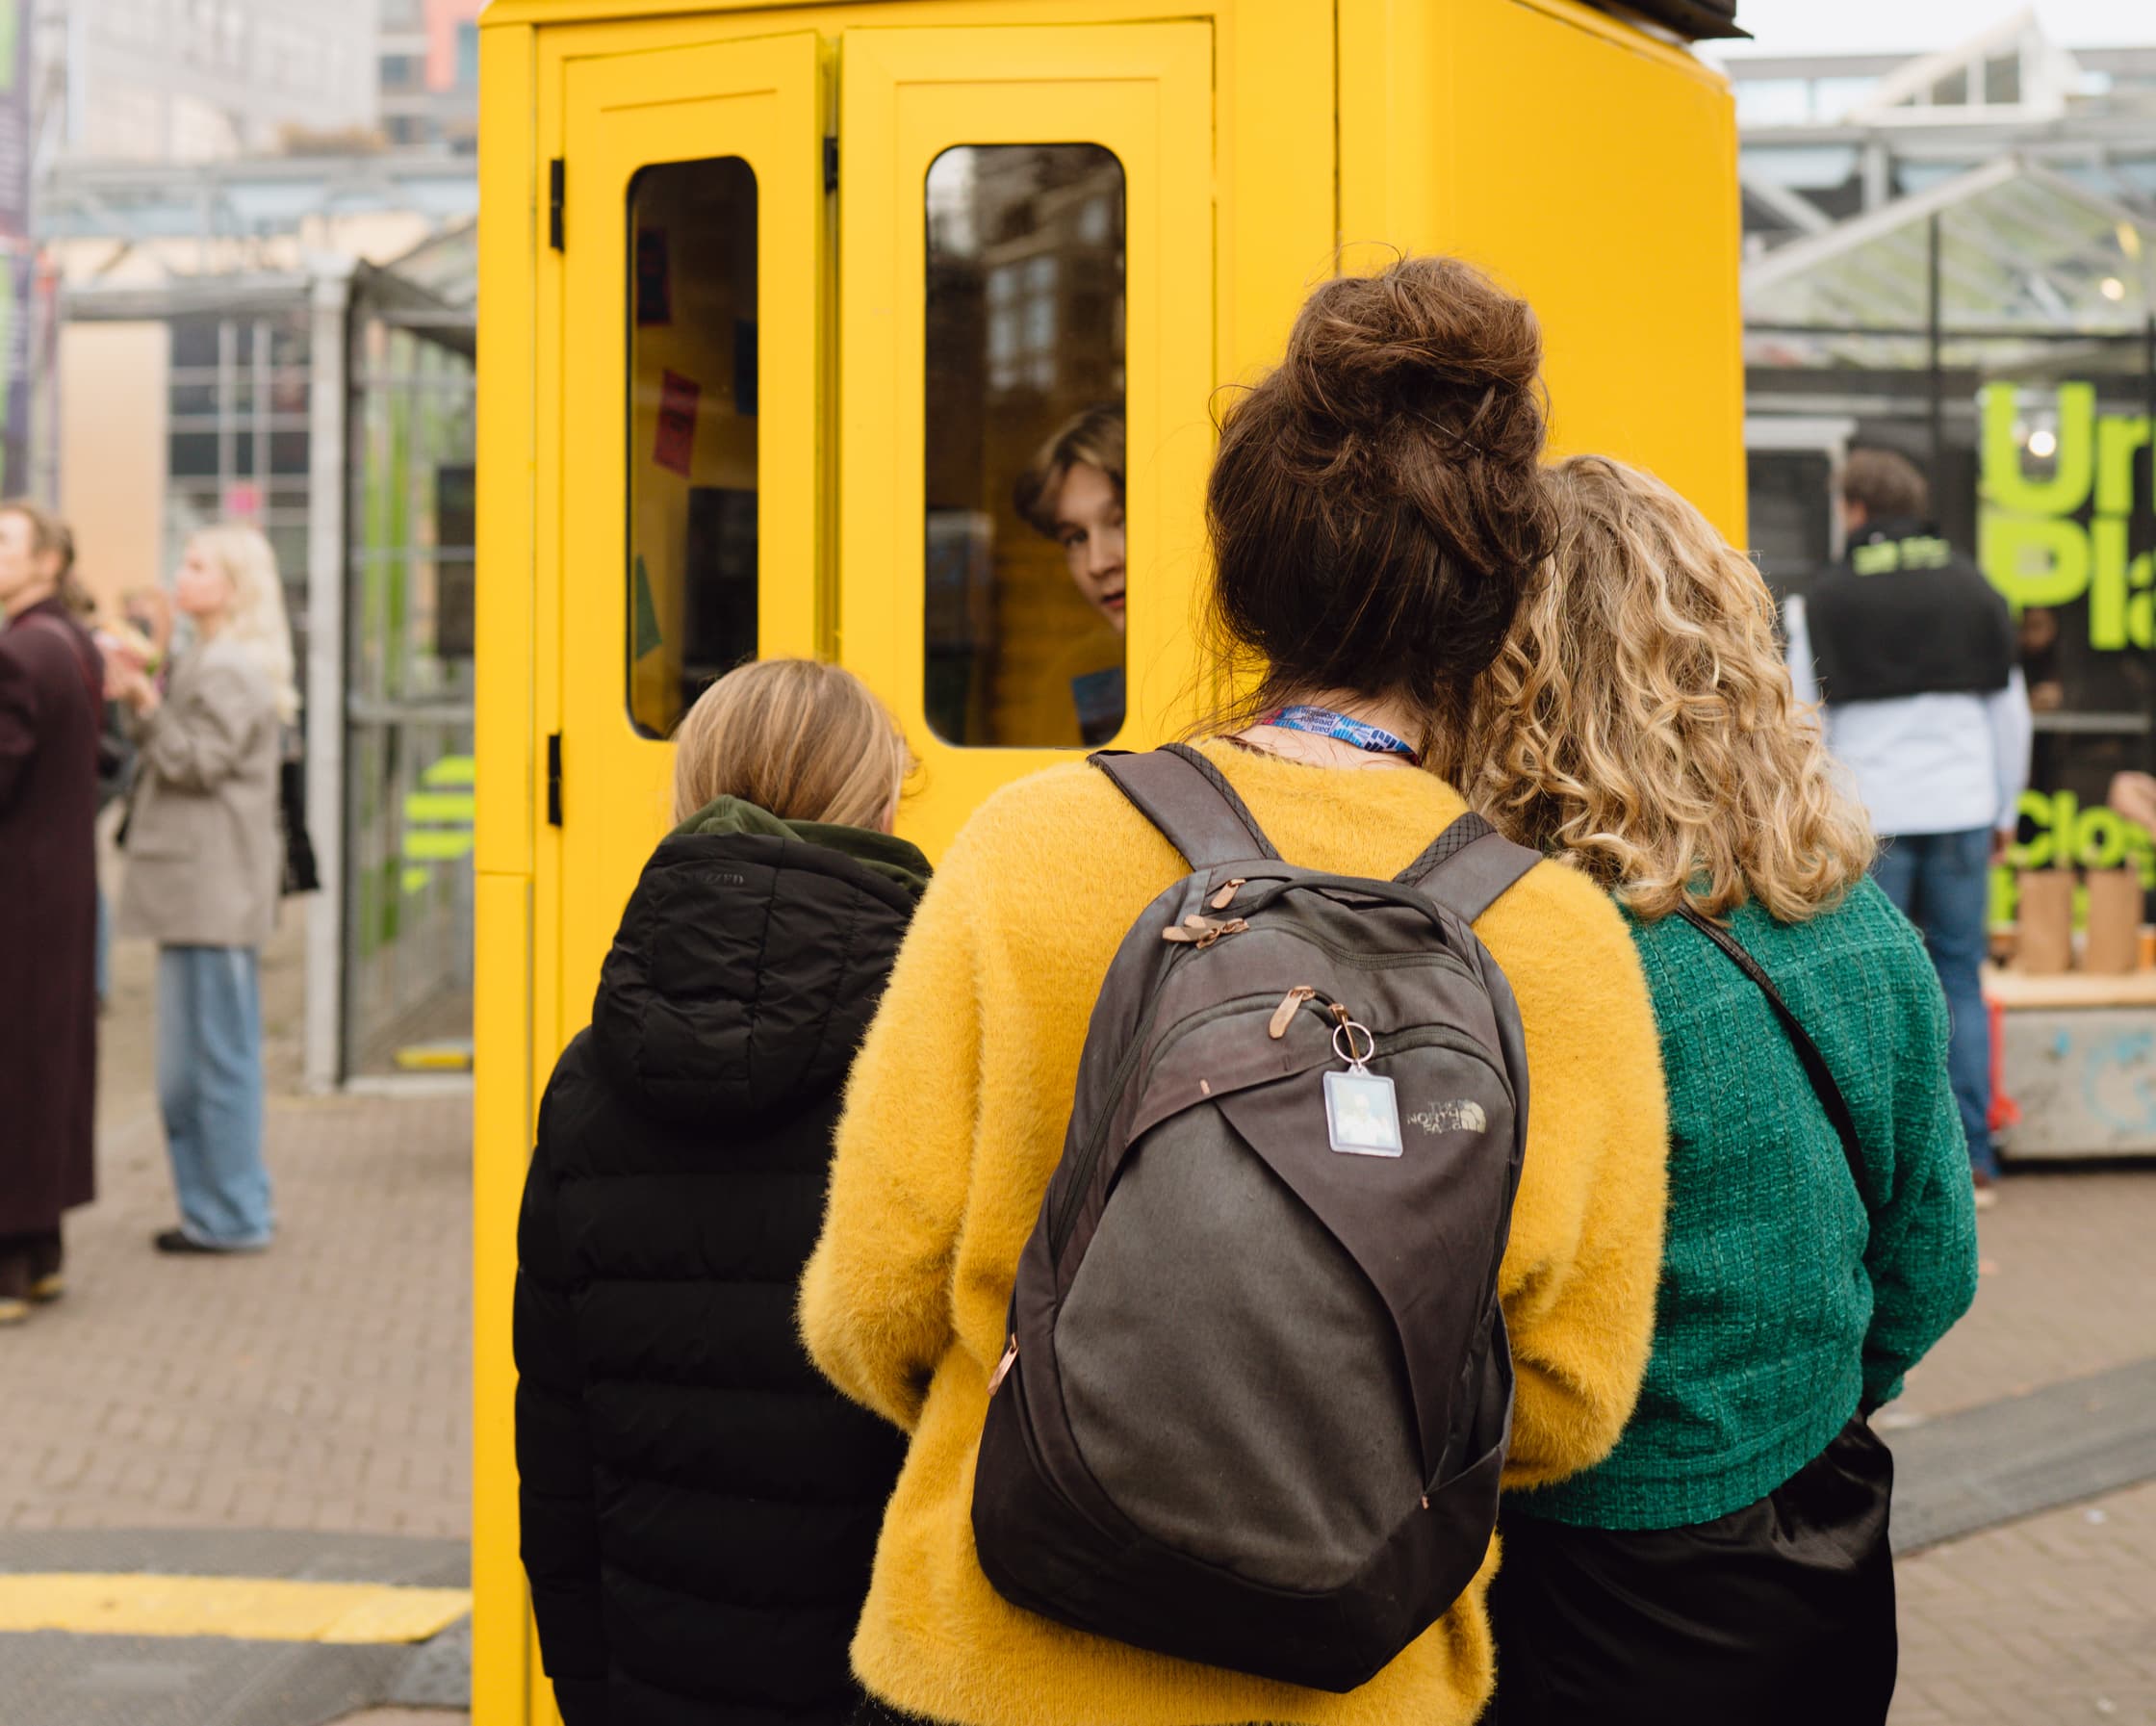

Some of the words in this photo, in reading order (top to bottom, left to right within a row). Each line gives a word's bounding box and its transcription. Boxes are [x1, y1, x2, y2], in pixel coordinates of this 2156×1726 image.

[1981, 381, 2156, 515] Ur
[1300, 715, 1334, 727] present
[1311, 724, 1330, 734] past
